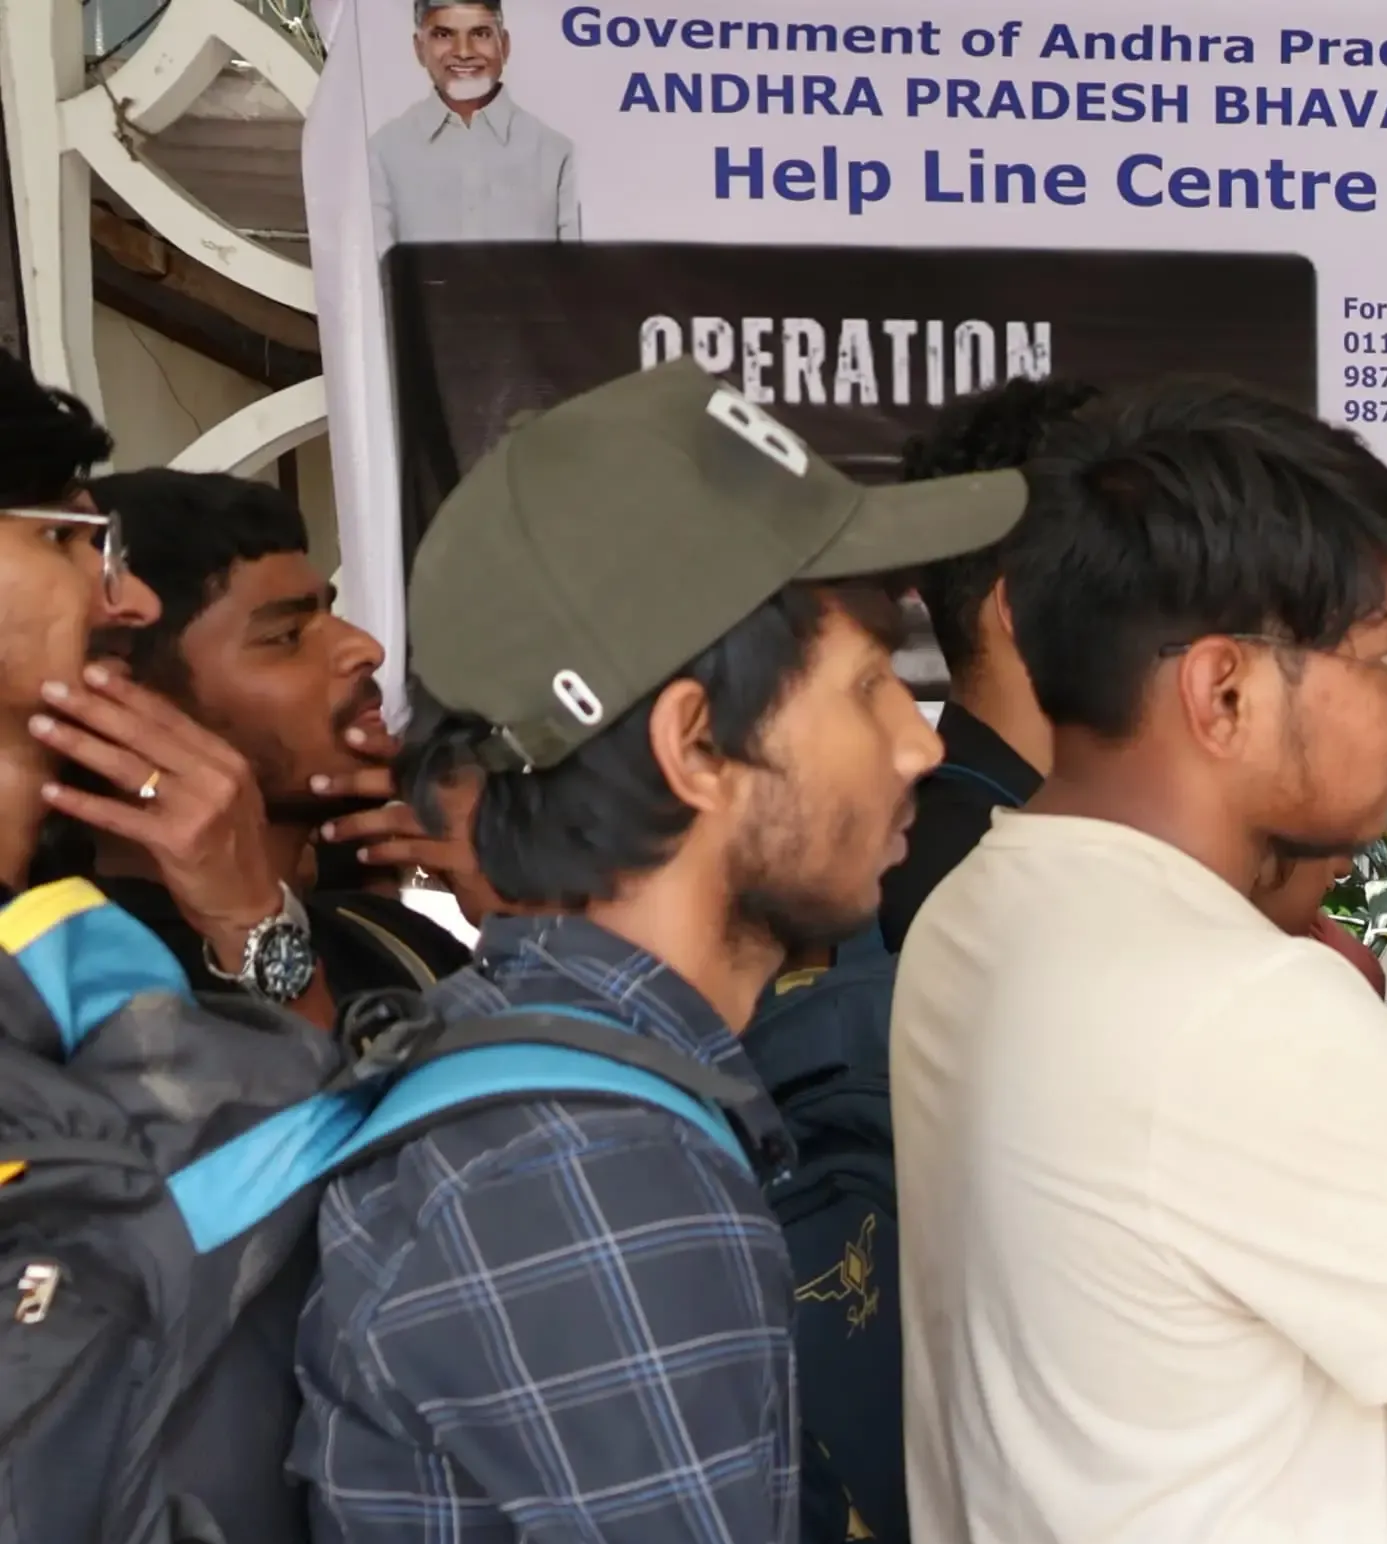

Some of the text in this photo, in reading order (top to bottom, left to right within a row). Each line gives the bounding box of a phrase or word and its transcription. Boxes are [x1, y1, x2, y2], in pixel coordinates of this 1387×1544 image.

[561, 6, 940, 57] Government
[961, 20, 1023, 58] of
[1040, 23, 1256, 64] Andhra
[620, 71, 883, 117] ANDHRA
[907, 77, 1190, 124] PRADESH
[715, 146, 1378, 215] Help Line Centre
[638, 313, 1053, 406] OPERATION
